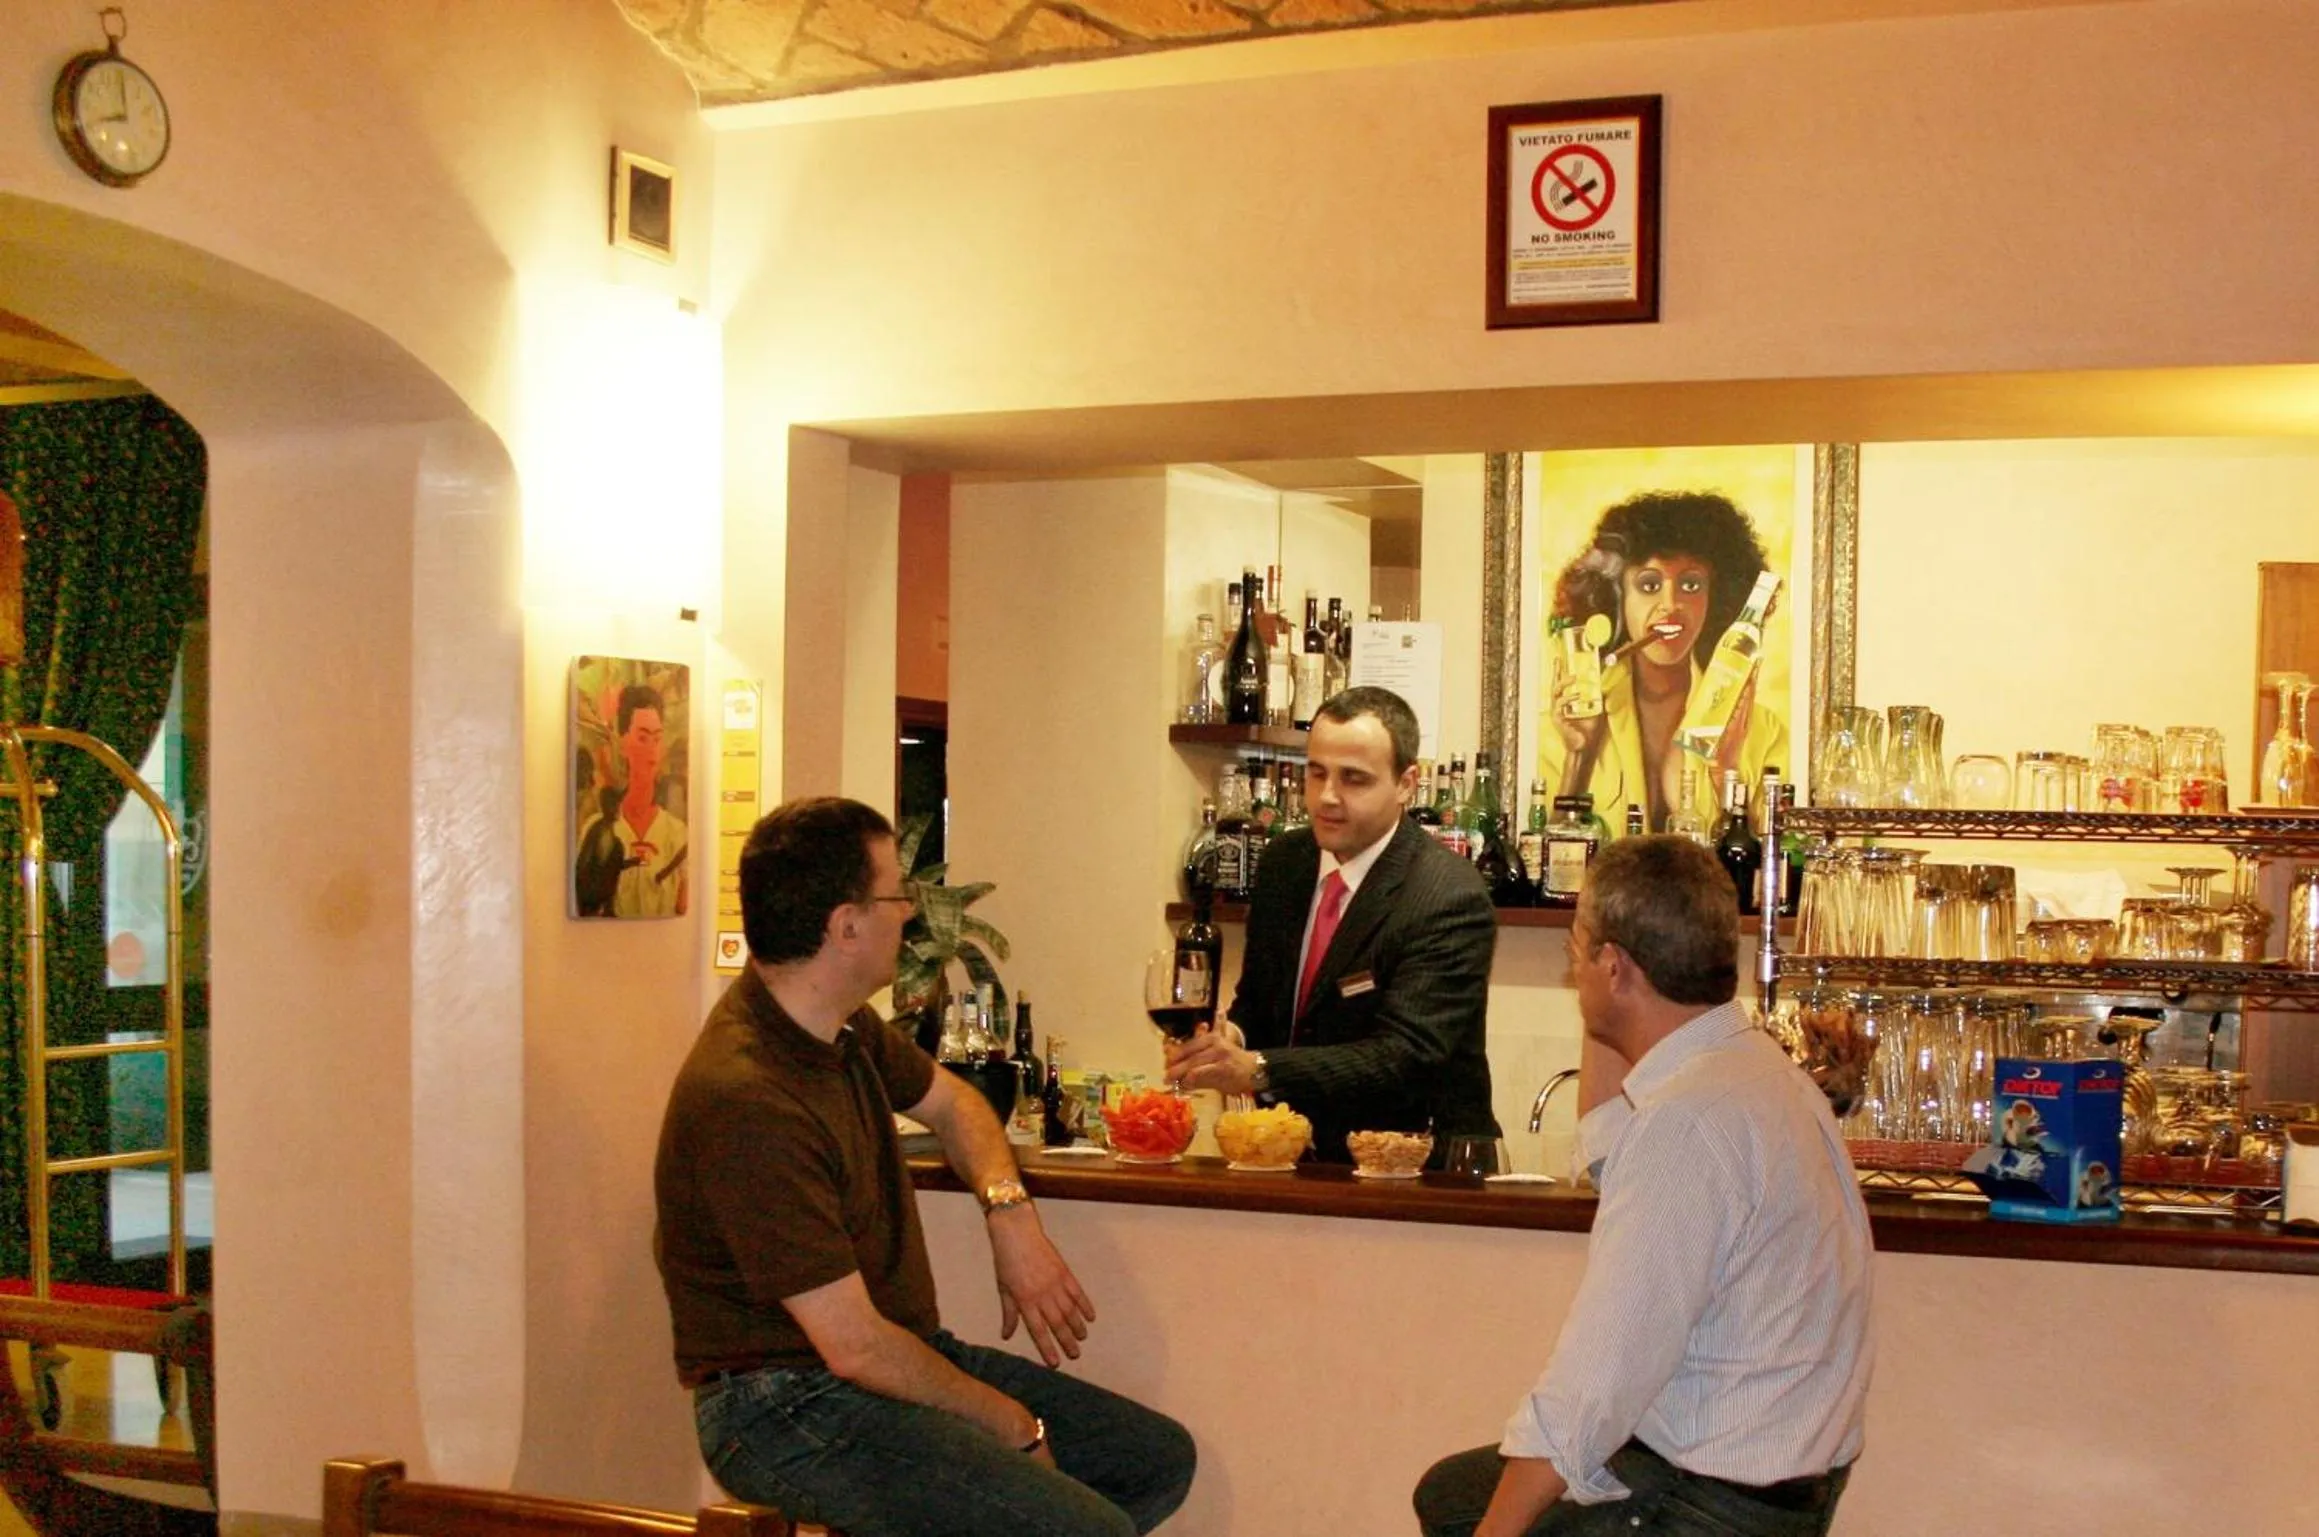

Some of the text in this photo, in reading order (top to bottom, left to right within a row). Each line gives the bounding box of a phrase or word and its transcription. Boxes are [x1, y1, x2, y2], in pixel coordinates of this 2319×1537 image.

[1518, 129, 1631, 147] VIETATO FUMARE
[1531, 230, 1616, 244] NO SMOKING
